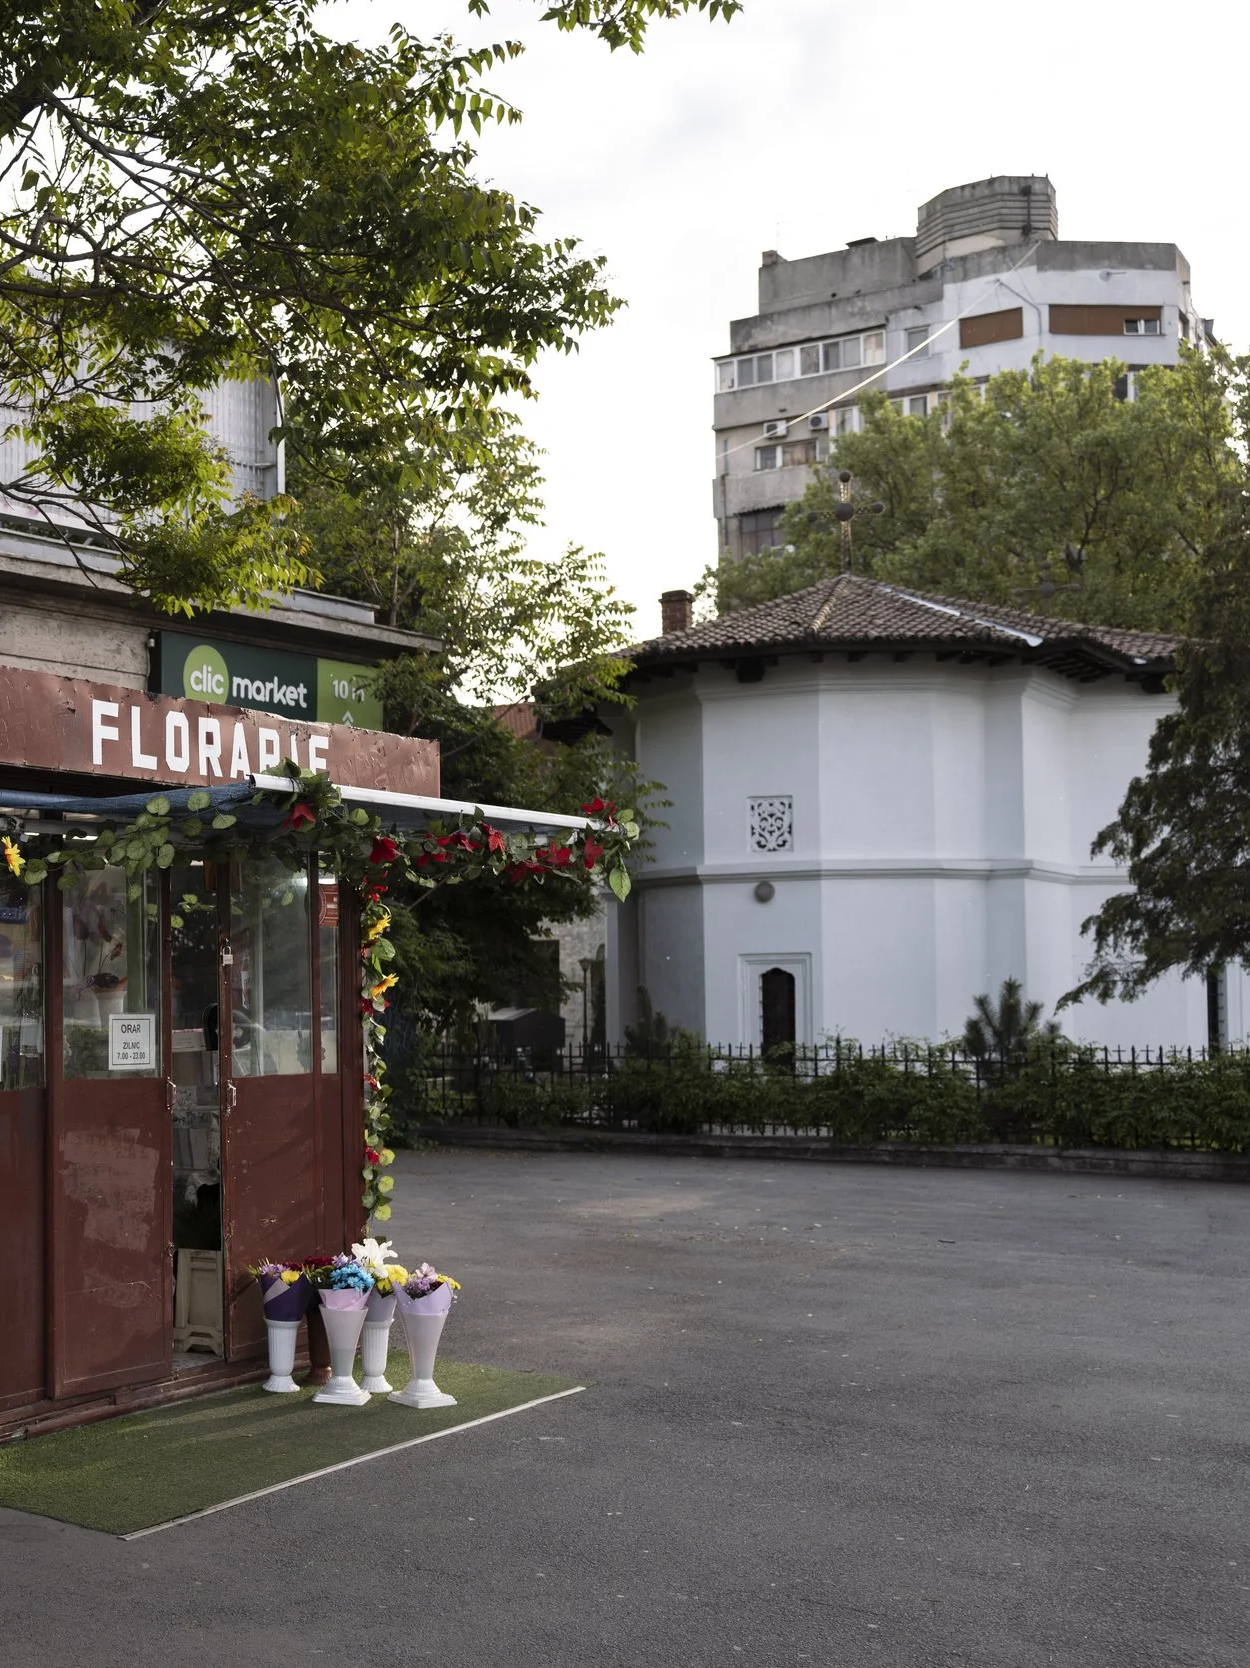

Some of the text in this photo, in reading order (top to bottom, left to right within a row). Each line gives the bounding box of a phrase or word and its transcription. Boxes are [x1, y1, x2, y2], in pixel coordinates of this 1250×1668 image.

[190, 664, 307, 708] clic market
[332, 679, 349, 700] 10
[92, 699, 330, 780] FLORARIE
[120, 1024, 141, 1034] ORAR
[122, 1041, 141, 1050] ZILNIC
